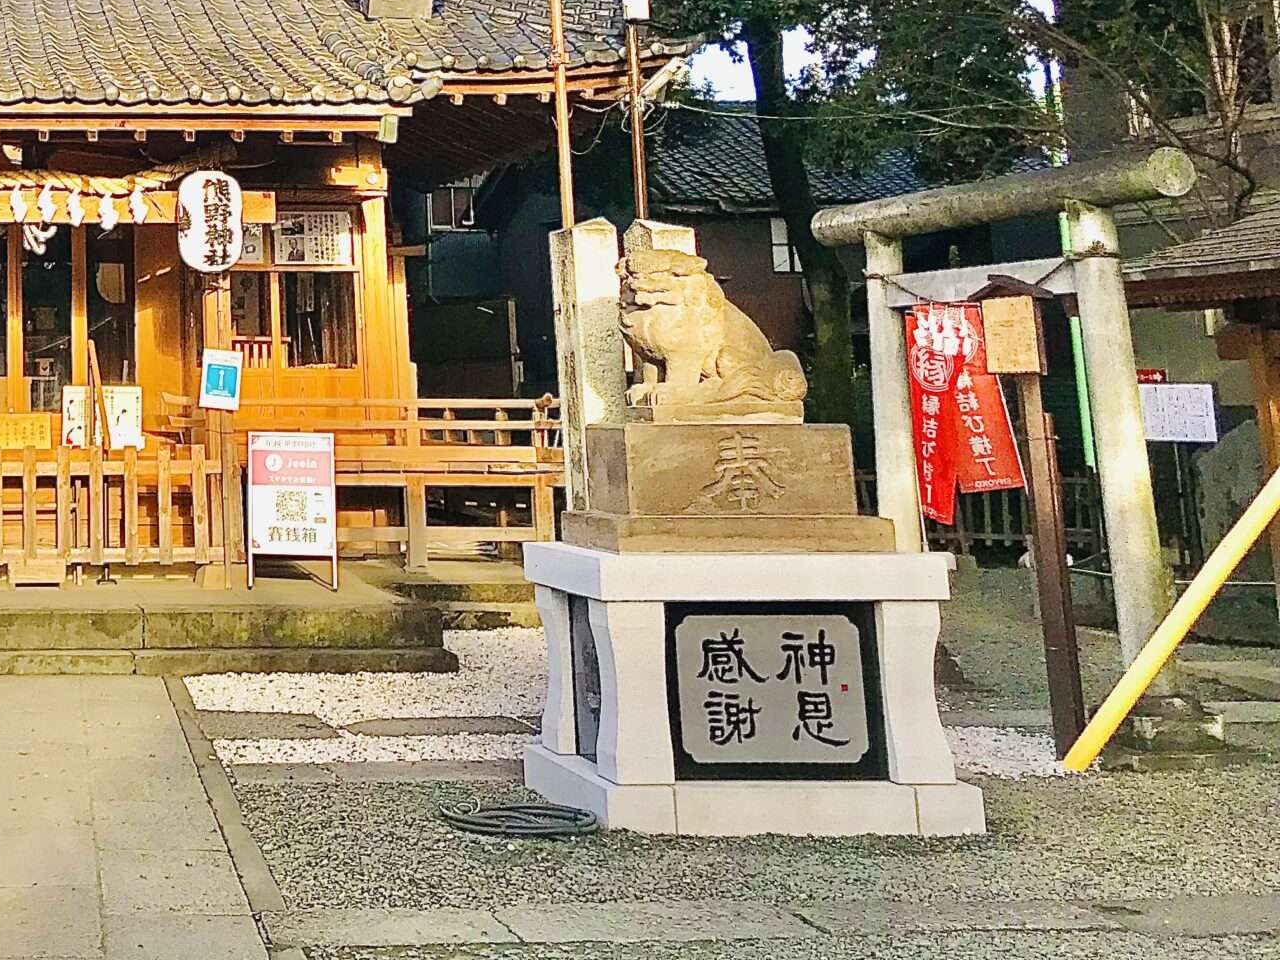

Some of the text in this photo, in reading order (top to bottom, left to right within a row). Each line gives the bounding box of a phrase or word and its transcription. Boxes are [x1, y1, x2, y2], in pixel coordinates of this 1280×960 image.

[202, 178, 233, 266] 熊野神社
[699, 431, 786, 512] 奉
[696, 628, 770, 746] 感謝
[776, 629, 851, 747] 神恩
